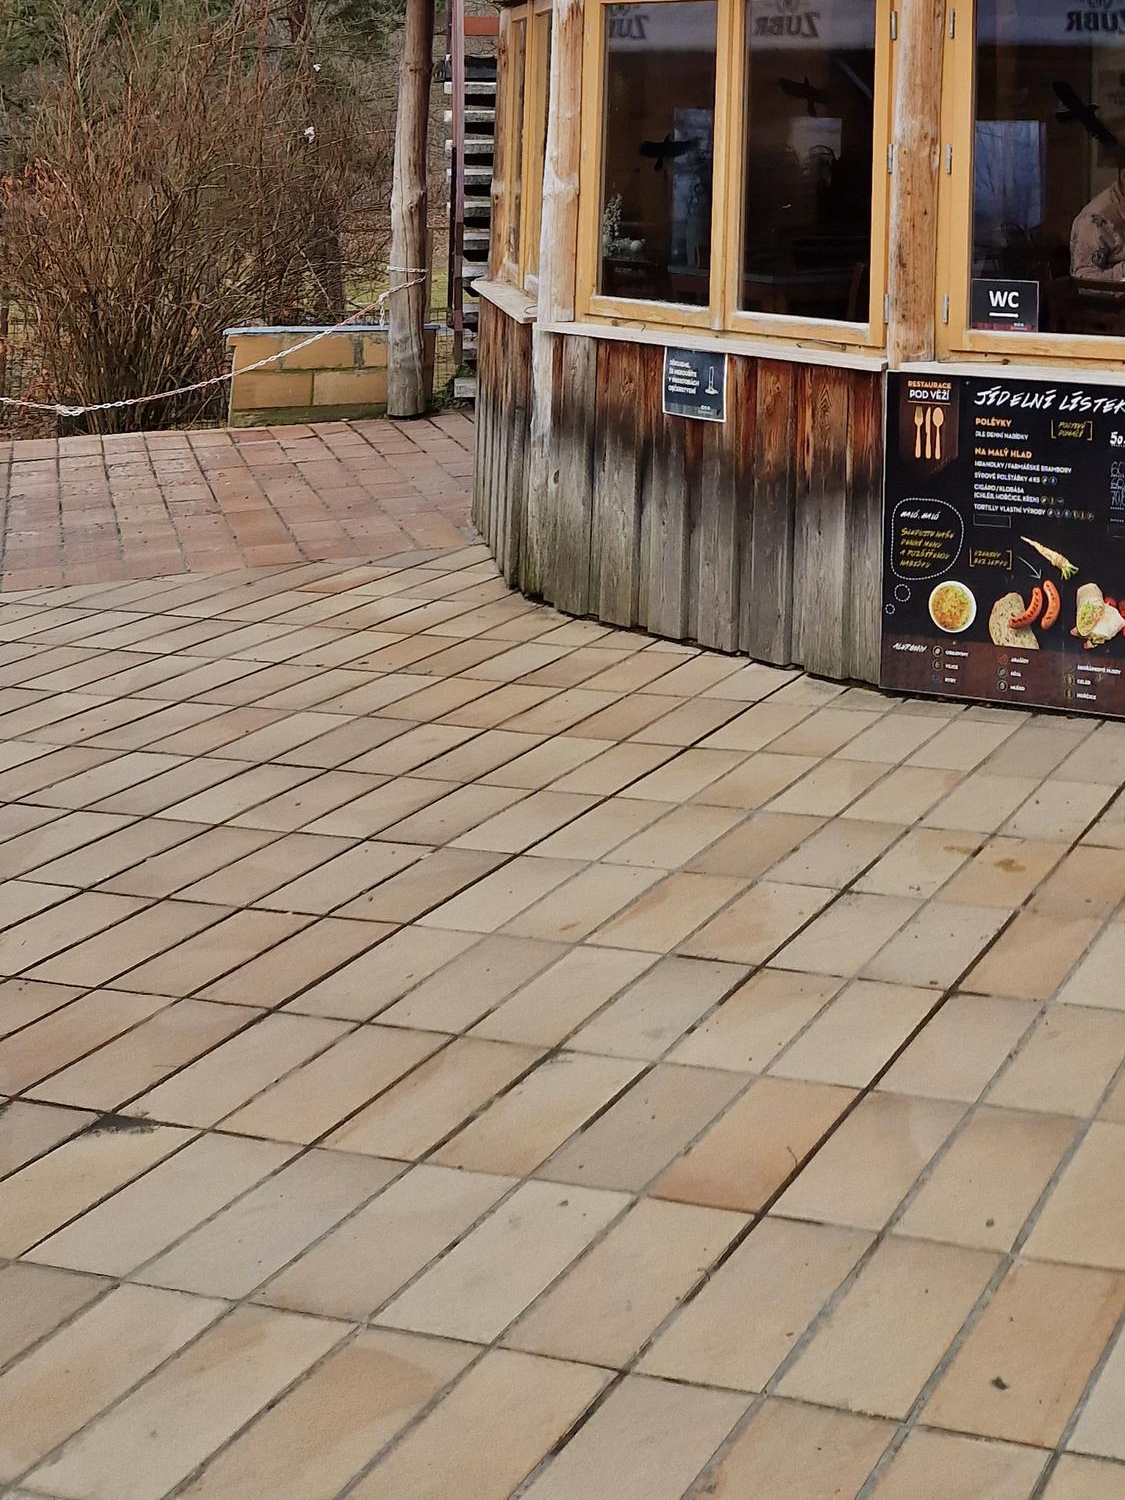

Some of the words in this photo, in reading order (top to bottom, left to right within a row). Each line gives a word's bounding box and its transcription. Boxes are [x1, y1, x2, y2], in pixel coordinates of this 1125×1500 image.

[989, 291, 1019, 308] WC
[908, 380, 952, 390] RESTAURACE
[909, 389, 928, 399] POD
[930, 388, 950, 401] VĚŽÍ
[974, 385, 1056, 410] JÍDELNÍ
[976, 416, 1012, 427] POLÉVKY
[987, 431, 1003, 439] DENNÍ
[1004, 432, 1029, 440] NABÍDKY
[988, 448, 1009, 457] MALÝ
[1011, 450, 1032, 458] HLAD
[975, 471, 996, 479] SÝROVÉ
[997, 473, 1027, 482] POLŠTÁŘKY
[1000, 506, 1022, 514] VLASTNÍ
[1023, 506, 1046, 515] VÝROBY
